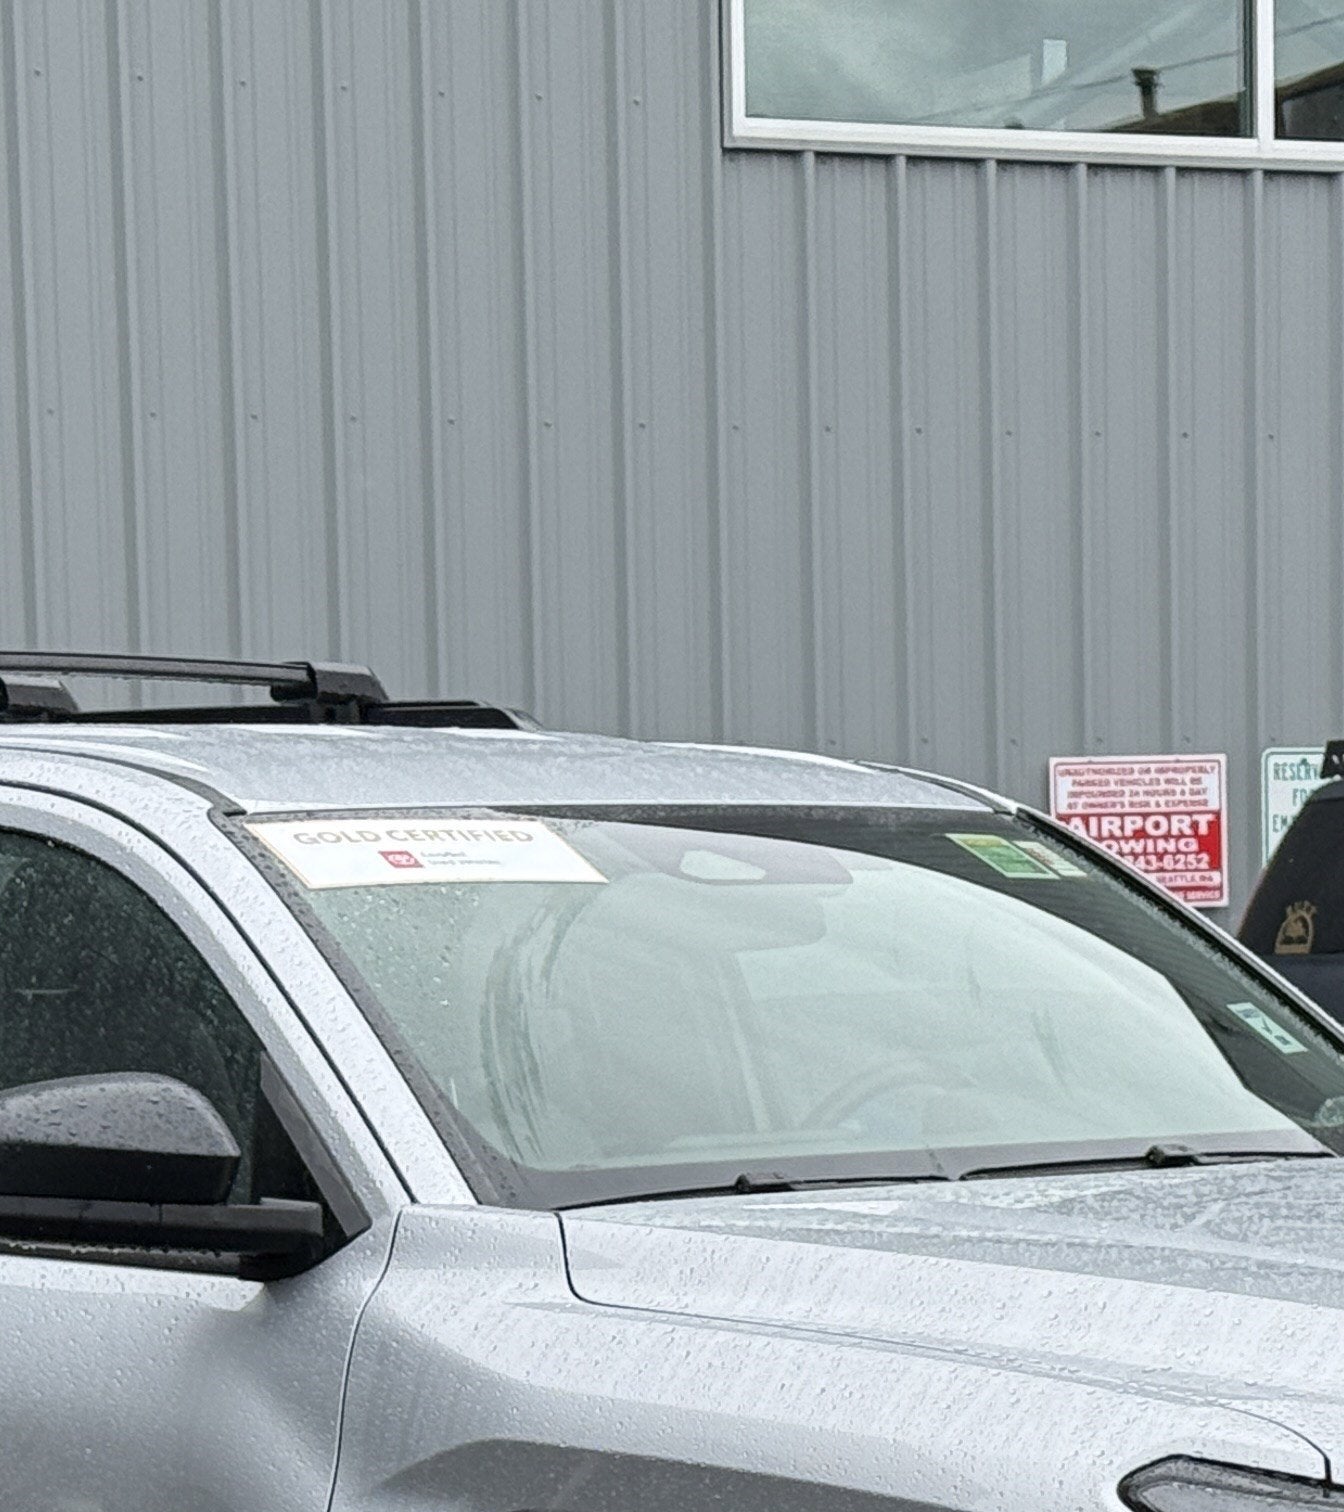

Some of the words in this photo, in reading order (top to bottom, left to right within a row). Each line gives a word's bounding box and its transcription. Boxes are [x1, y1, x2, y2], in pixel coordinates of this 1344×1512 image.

[1068, 814, 1216, 837] AIRPORT
[293, 829, 381, 845] GOLD
[386, 828, 534, 843] CERTIFIED
[1101, 837, 1199, 853] OWING
